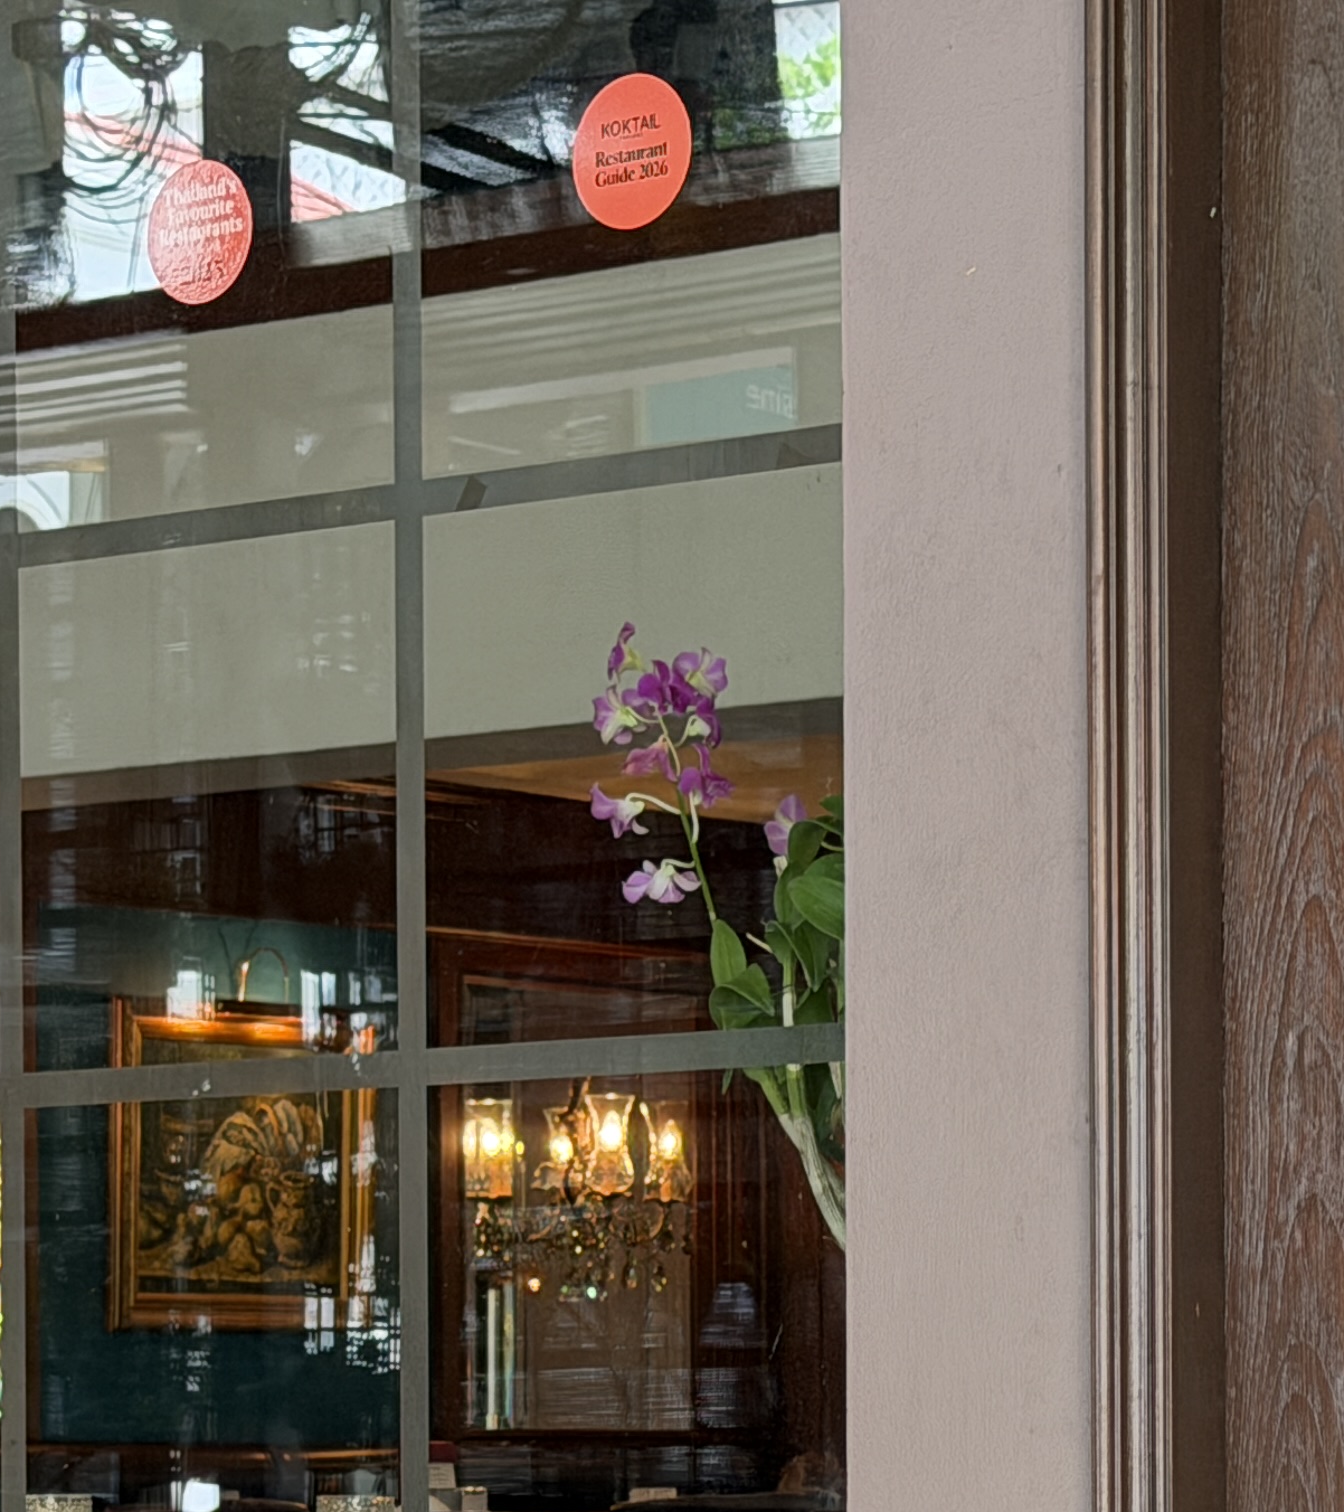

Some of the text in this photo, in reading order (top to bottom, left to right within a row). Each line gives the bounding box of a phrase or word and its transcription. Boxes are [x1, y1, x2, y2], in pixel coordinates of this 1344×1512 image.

[601, 113, 661, 139] KOKTAIL
[595, 142, 667, 168] Restaurant
[595, 160, 668, 187] Guide 2026
